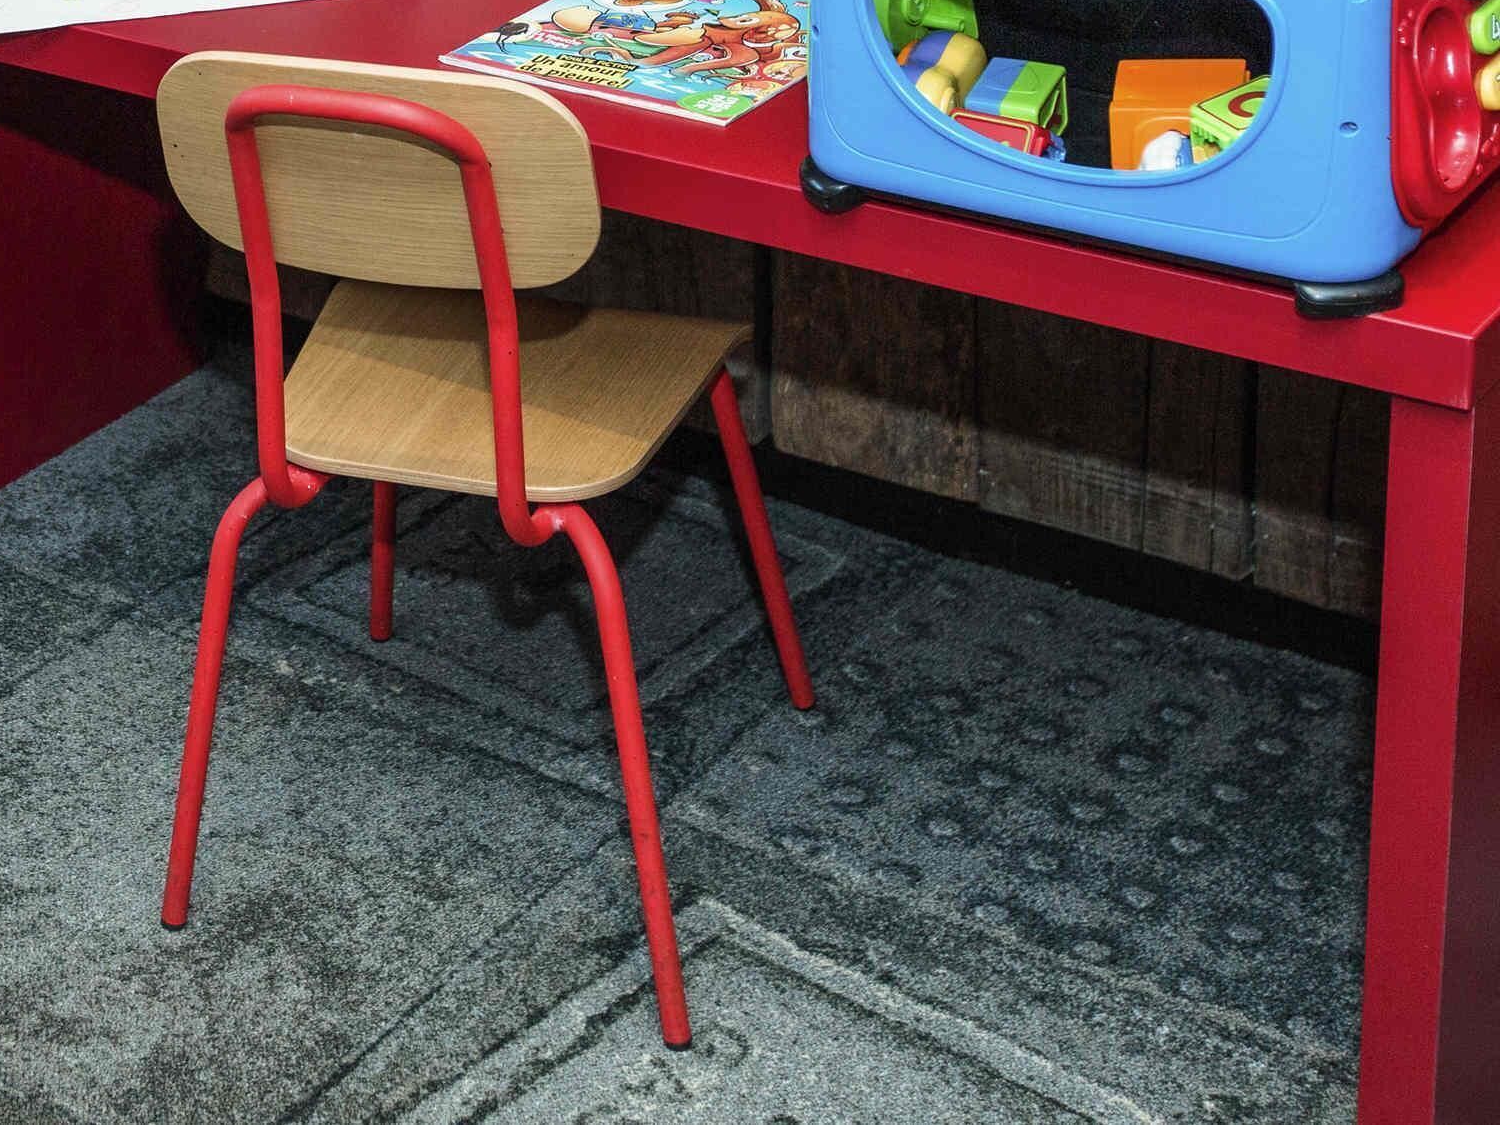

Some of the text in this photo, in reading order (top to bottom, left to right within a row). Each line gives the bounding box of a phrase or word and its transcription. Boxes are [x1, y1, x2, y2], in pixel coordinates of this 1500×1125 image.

[520, 63, 633, 88] de pieuvre!
[532, 54, 624, 78] Un amour
